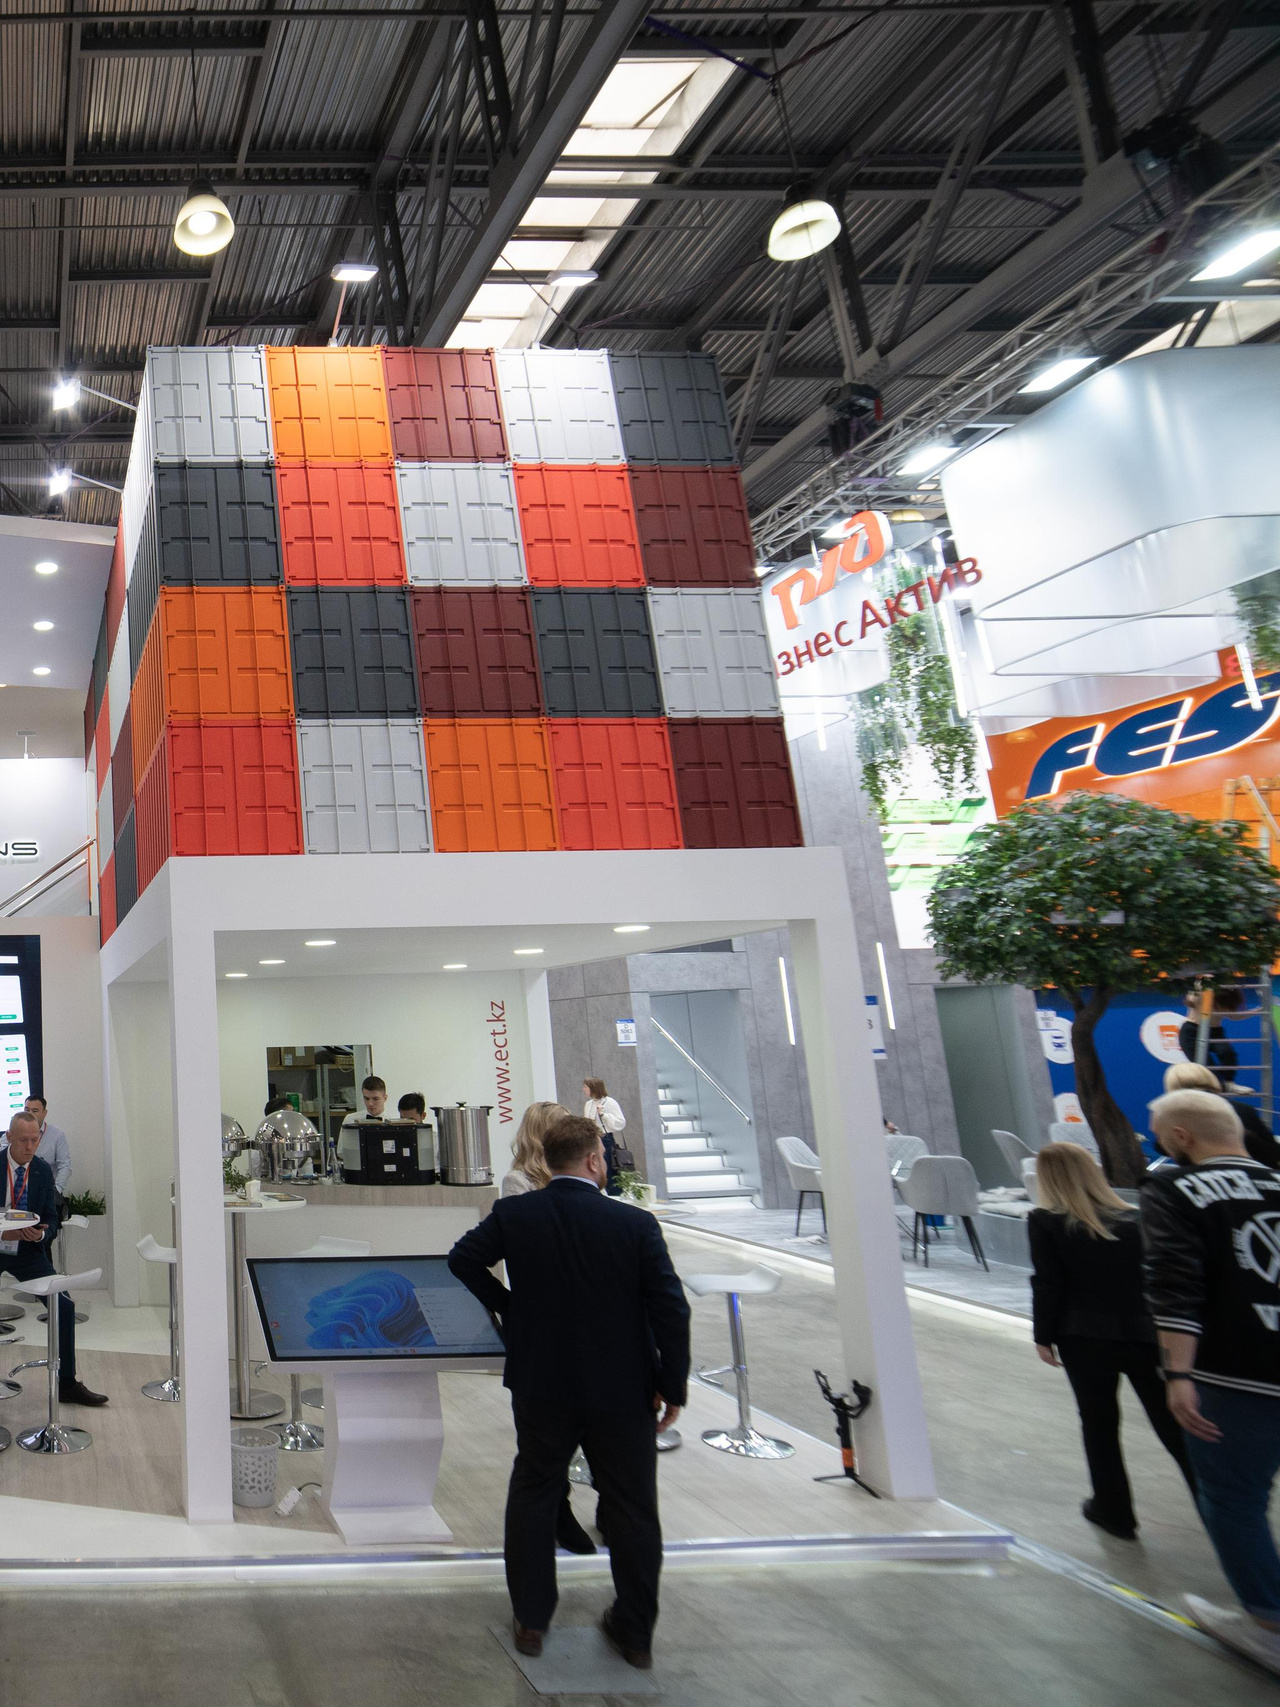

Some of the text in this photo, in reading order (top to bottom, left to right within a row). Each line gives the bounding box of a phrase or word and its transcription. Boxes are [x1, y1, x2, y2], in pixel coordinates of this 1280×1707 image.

[774, 557, 983, 679] знес Актив
[486, 1000, 513, 1123] www.ect.kz
